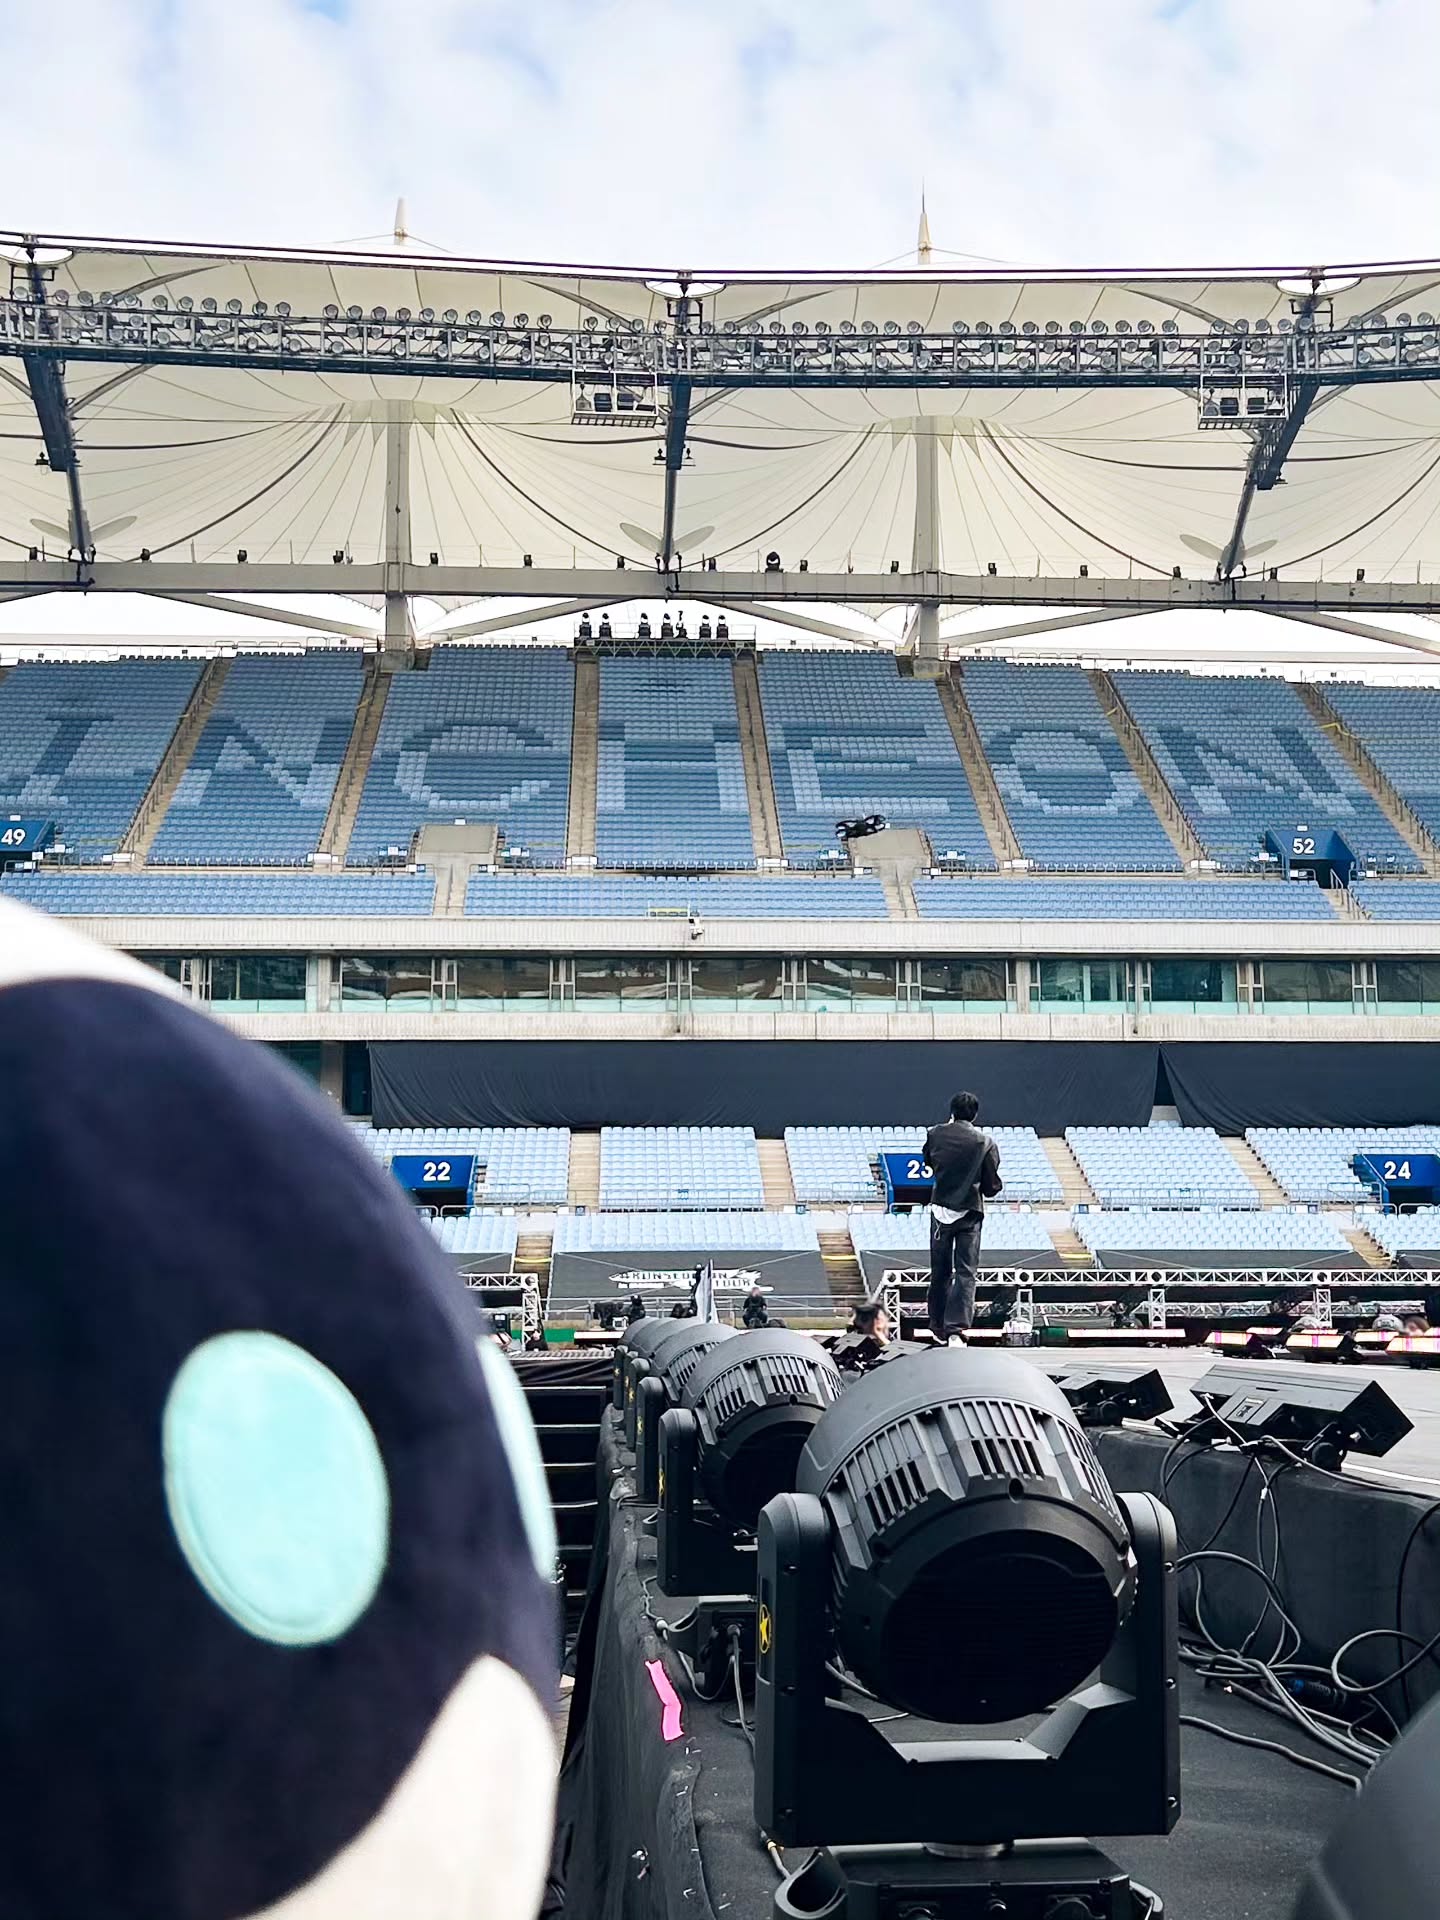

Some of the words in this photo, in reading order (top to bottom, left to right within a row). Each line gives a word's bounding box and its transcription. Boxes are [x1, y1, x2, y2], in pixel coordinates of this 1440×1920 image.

[1, 828, 26, 845] 49
[1293, 838, 1315, 854] 52
[423, 1161, 451, 1182] 22
[907, 1159, 934, 1179] 23
[1384, 1160, 1411, 1180] 24
